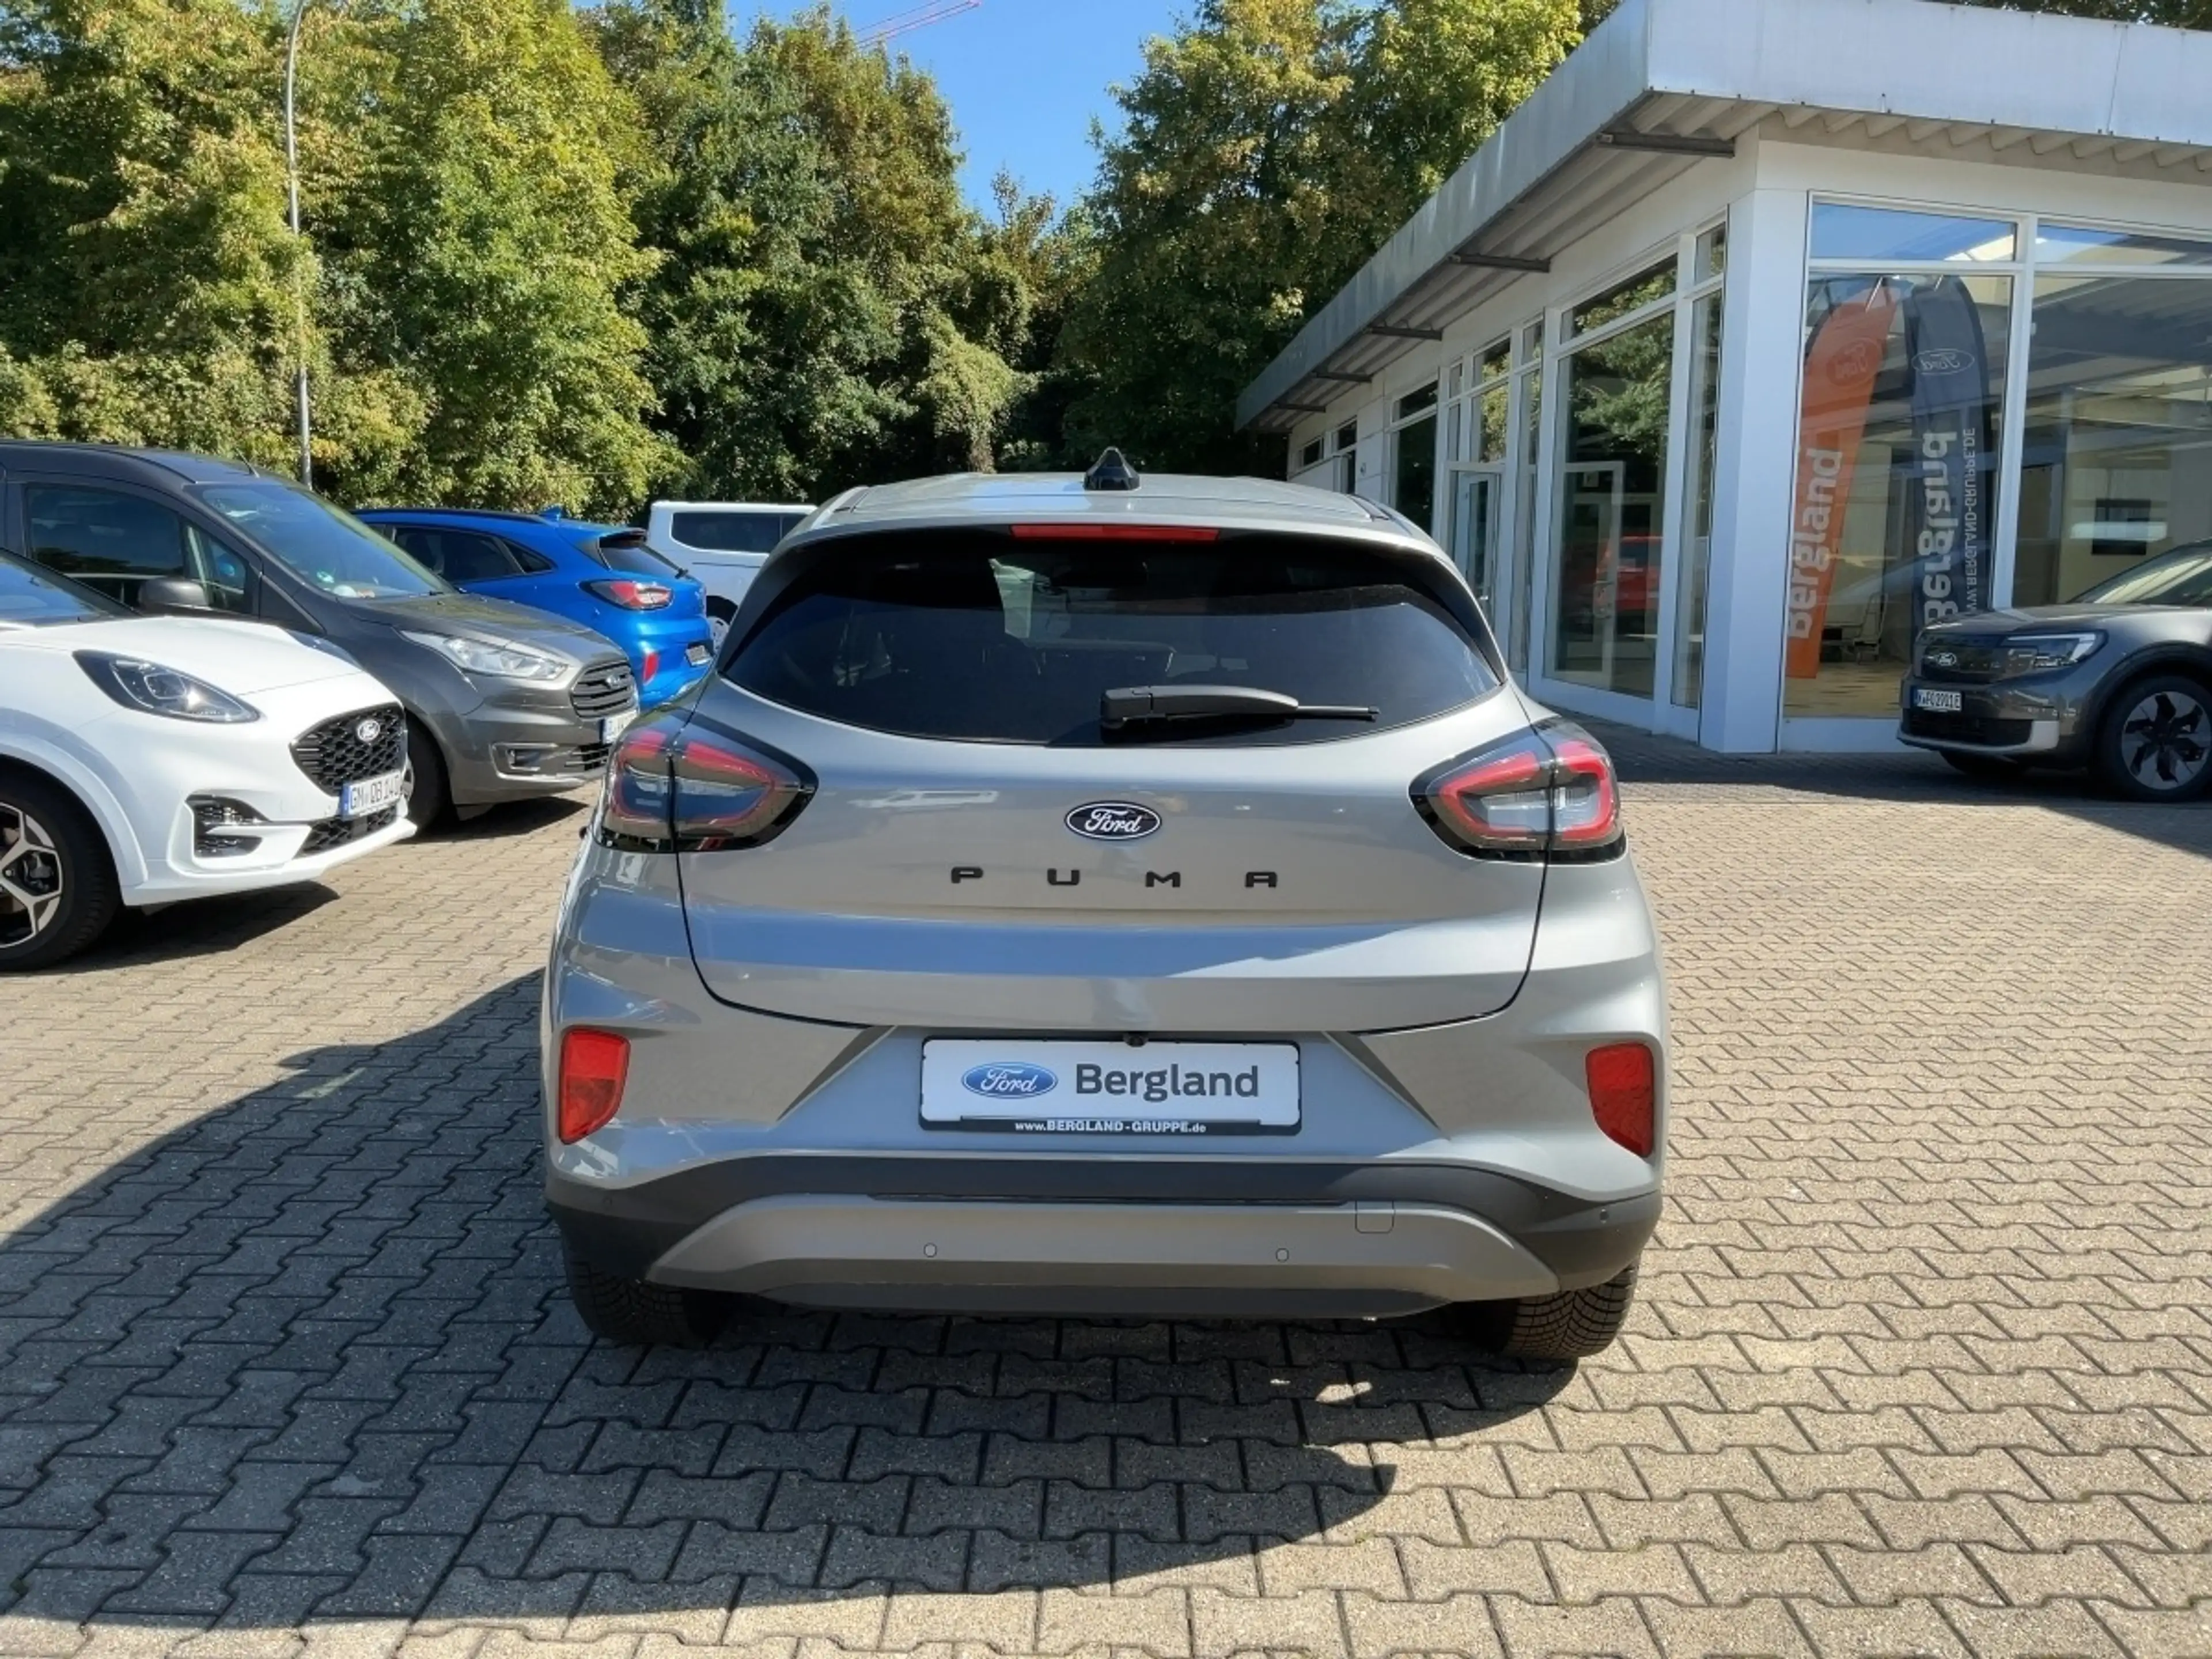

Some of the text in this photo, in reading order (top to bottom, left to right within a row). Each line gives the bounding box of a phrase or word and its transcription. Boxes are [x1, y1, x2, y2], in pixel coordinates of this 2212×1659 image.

[1084, 808, 1141, 833] Ford
[950, 866, 1278, 888] PUMA
[980, 1063, 1259, 1103] Ford Bergland
[1014, 1119, 1207, 1133] www.BERGLAND-GRUPPE.de
